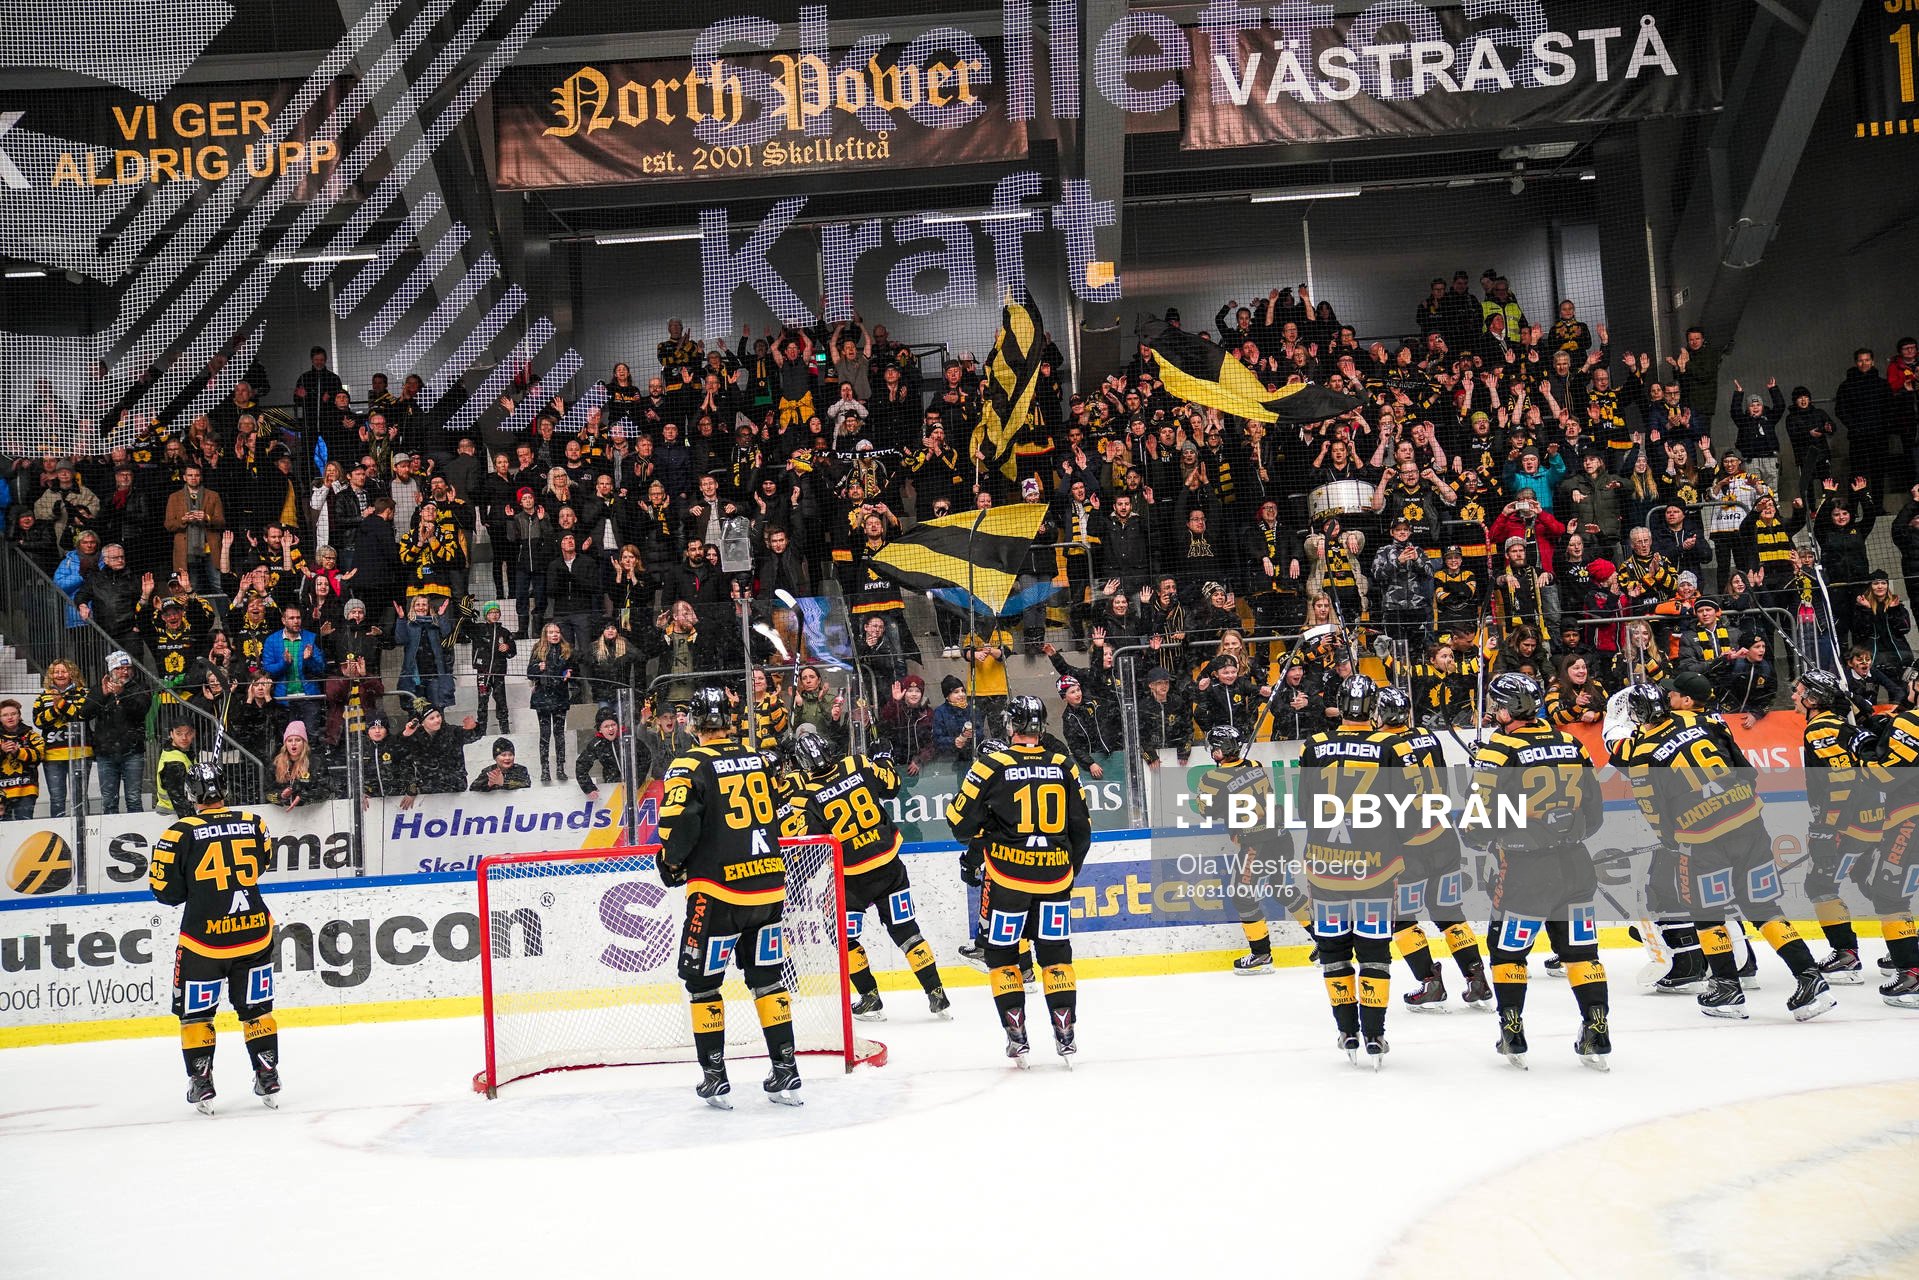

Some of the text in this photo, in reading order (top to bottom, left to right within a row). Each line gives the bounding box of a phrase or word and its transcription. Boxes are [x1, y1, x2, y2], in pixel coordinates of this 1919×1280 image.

[1215, 14, 1679, 105] VÄSTRA STÅ
[542, 52, 983, 137] North Power
[112, 100, 271, 141] VI GER
[51, 145, 230, 188] ALDRIG
[245, 140, 337, 178] UPP
[642, 130, 891, 174] est. 2001 Skellefteå
[698, 171, 1122, 340] Kraft
[1319, 742, 1382, 759] BOLIDEN
[1410, 735, 1436, 749] LIDEN
[1658, 726, 1709, 758] BOLIDEN
[1010, 766, 1064, 780] BOLIDEN
[1670, 738, 1732, 793] 16
[718, 772, 774, 830] 38
[820, 772, 865, 803] BOLIDEN
[1013, 783, 1066, 833] 10
[1320, 759, 1381, 815] 17
[1522, 763, 1584, 817] 23
[199, 822, 256, 840] BOLIDEN
[391, 801, 612, 840] Holmlunds
[823, 786, 881, 843] 28
[852, 829, 881, 851] ALM
[991, 842, 1069, 866] LINDSTRÖM
[1306, 844, 1382, 868] LINDHOLM
[1888, 819, 1916, 865] REPAY
[194, 839, 259, 891] 45
[724, 857, 786, 881] ERIKSSO
[1679, 855, 1692, 905] REPAY
[205, 911, 266, 935] MÖLLER
[0, 923, 153, 973] utec
[47, 983, 81, 1008] for
[88, 975, 154, 1006] Wood
[247, 1026, 272, 1039] ORRAN
